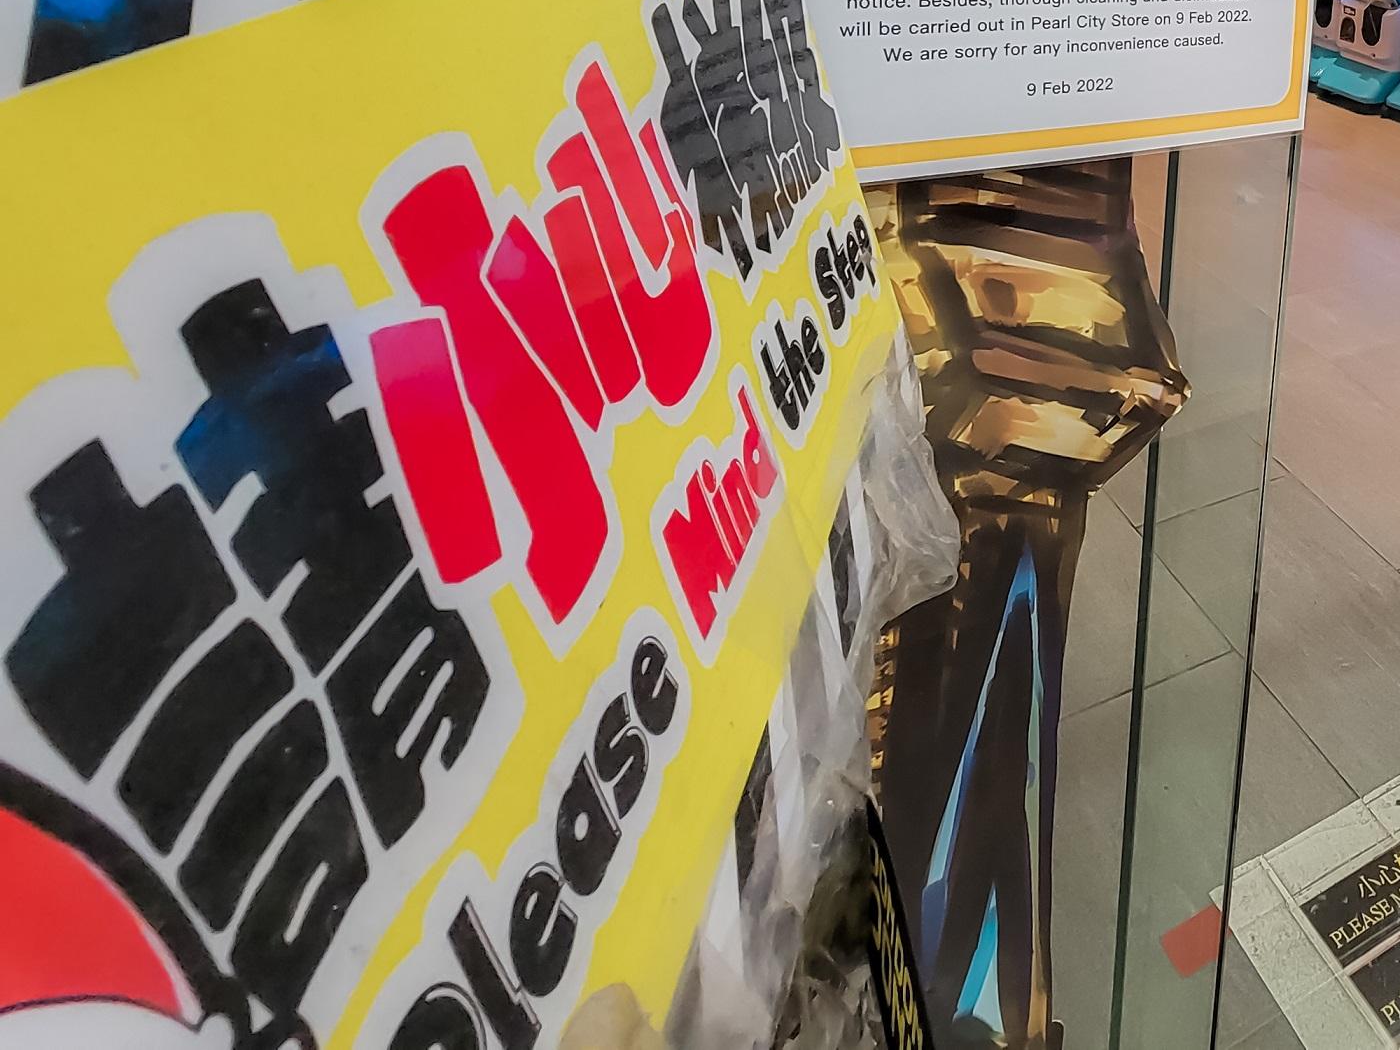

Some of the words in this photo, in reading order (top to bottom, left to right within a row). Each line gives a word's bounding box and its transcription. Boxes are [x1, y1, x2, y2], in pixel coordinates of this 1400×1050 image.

[839, 21, 871, 37] will
[879, 20, 902, 36] be
[908, 18, 971, 35] carried
[977, 18, 1005, 32] out
[1011, 17, 1025, 31] in
[1031, 15, 1071, 30] Pearl
[1076, 14, 1106, 31] City
[1111, 13, 1150, 27] Store
[1154, 15, 1171, 26] on
[1176, 11, 1184, 25] 9
[1189, 11, 1213, 24] Feb
[1217, 9, 1252, 23] 2022.
[883, 47, 913, 63] We
[920, 48, 948, 61] are
[954, 46, 998, 61] sorry
[1003, 42, 1028, 57] for
[1033, 43, 1061, 57] any
[1066, 38, 1169, 53] inconvenience
[1174, 32, 1224, 47] caused.
[1026, 82, 1037, 97] 9
[1042, 80, 1071, 95] Feb
[1076, 77, 1114, 93] 2022
[662, 385, 778, 642] Mind
[760, 315, 825, 431] the
[814, 213, 876, 331] Step
[1328, 898, 1395, 949] PLEASE
